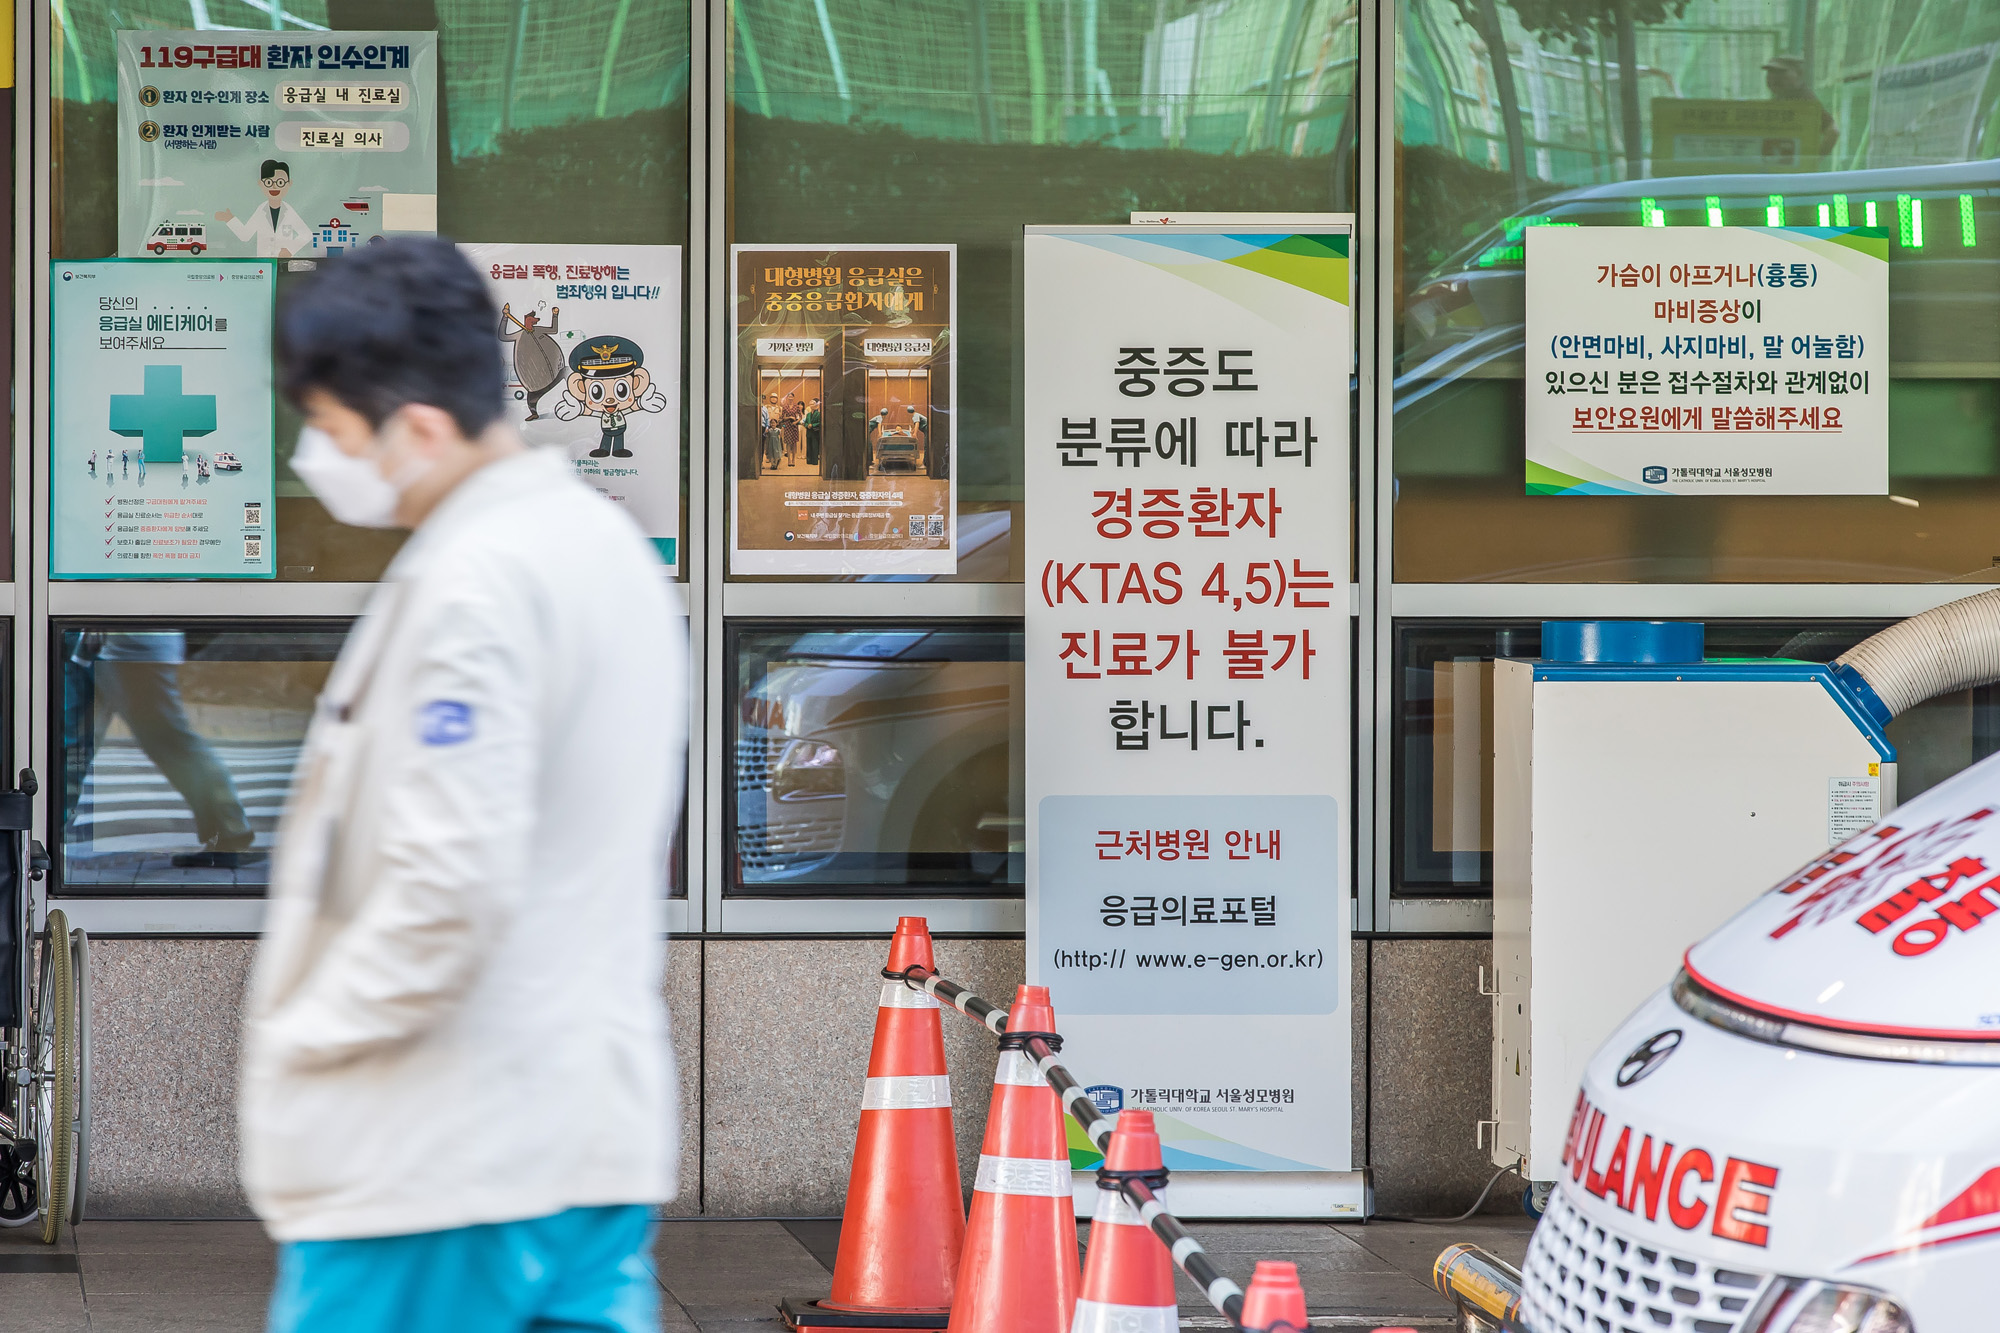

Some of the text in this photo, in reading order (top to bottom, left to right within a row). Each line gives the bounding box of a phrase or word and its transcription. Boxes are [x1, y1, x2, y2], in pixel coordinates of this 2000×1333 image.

[140, 45, 410, 69] 119구급대 환자 인수인계
[163, 90, 187, 104] 환자
[245, 90, 270, 104] 장소
[284, 87, 400, 104] 응급실 내 진료실
[162, 124, 188, 138] 환자
[192, 124, 241, 138] 인계받는
[245, 124, 270, 138] 사람
[302, 131, 382, 147] 진료실 의사
[164, 139, 217, 150] (서명하는 사람)
[490, 264, 630, 281] 응급실 폭행, 진료방해는
[765, 267, 924, 287] 대형병원 응급실은
[1597, 263, 1818, 288] 가슴이 아프거나(흉통)
[557, 285, 660, 300] 범죄행위 입니다!!
[765, 292, 924, 312] 중증응급환자에게
[99, 297, 138, 311] 당신의
[1654, 299, 1762, 324] 마비증상이
[99, 314, 227, 332] 응급실 에티케어를
[99, 336, 165, 350] 보여주세요
[768, 342, 813, 353] 가까운 병원
[867, 342, 930, 353] 대형병원 응급실
[1550, 335, 1865, 361] (안면마비, 사지마비, 말 어눌함)
[1114, 347, 1259, 397] 중증도
[1545, 370, 1869, 395] 있으신 분은 접수절차와 관계없이
[1572, 406, 1843, 431] 보안요원에게 말씀해주세요
[1056, 416, 1318, 468] 분류에 따라
[1671, 467, 1773, 477] 가톨릭대학교 서울성모병원
[1091, 487, 1282, 539] 경증환자
[1041, 558, 1334, 612] (KTAS 4,5)는
[1059, 629, 1316, 680] 진료가 불가
[1109, 700, 1264, 751] 합니다.
[1095, 829, 1281, 861] 근처병원 안내
[1100, 895, 1277, 927] 응급의료포털
[1054, 949, 1323, 972] (http:// www.e-gen.or.kr)
[1130, 1088, 1294, 1103] 가톨릭대학교 서울성모병원
